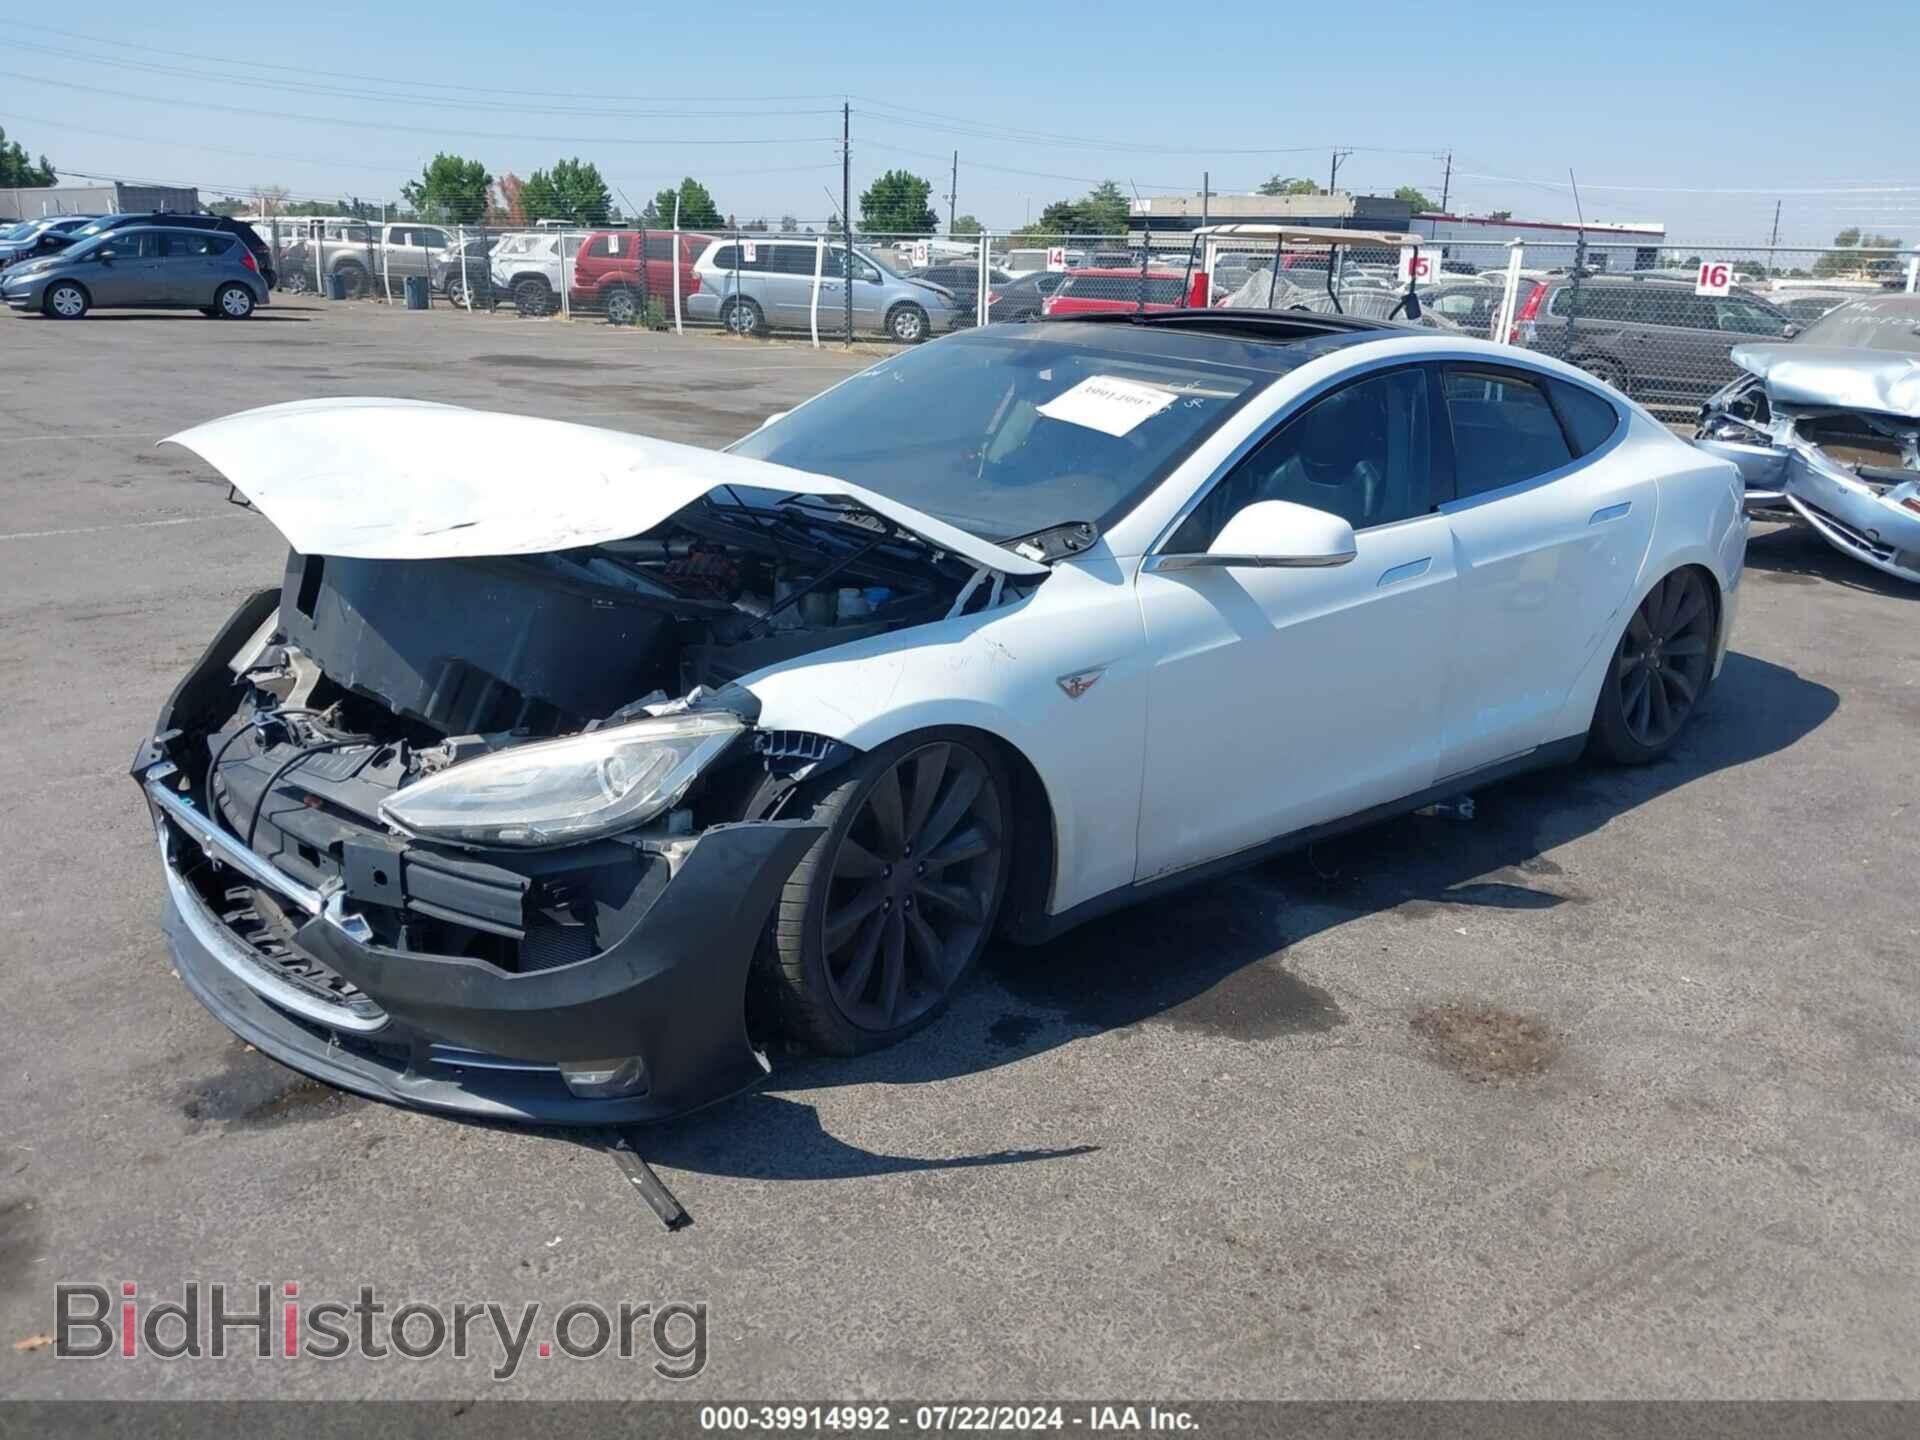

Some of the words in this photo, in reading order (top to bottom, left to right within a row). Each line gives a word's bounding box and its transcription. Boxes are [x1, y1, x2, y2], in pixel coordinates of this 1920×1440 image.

[746, 242, 754, 256] 12
[913, 246, 925, 261] 13
[1049, 251, 1063, 264] 14
[1408, 257, 1429, 276] 15
[1701, 265, 1729, 287] 16
